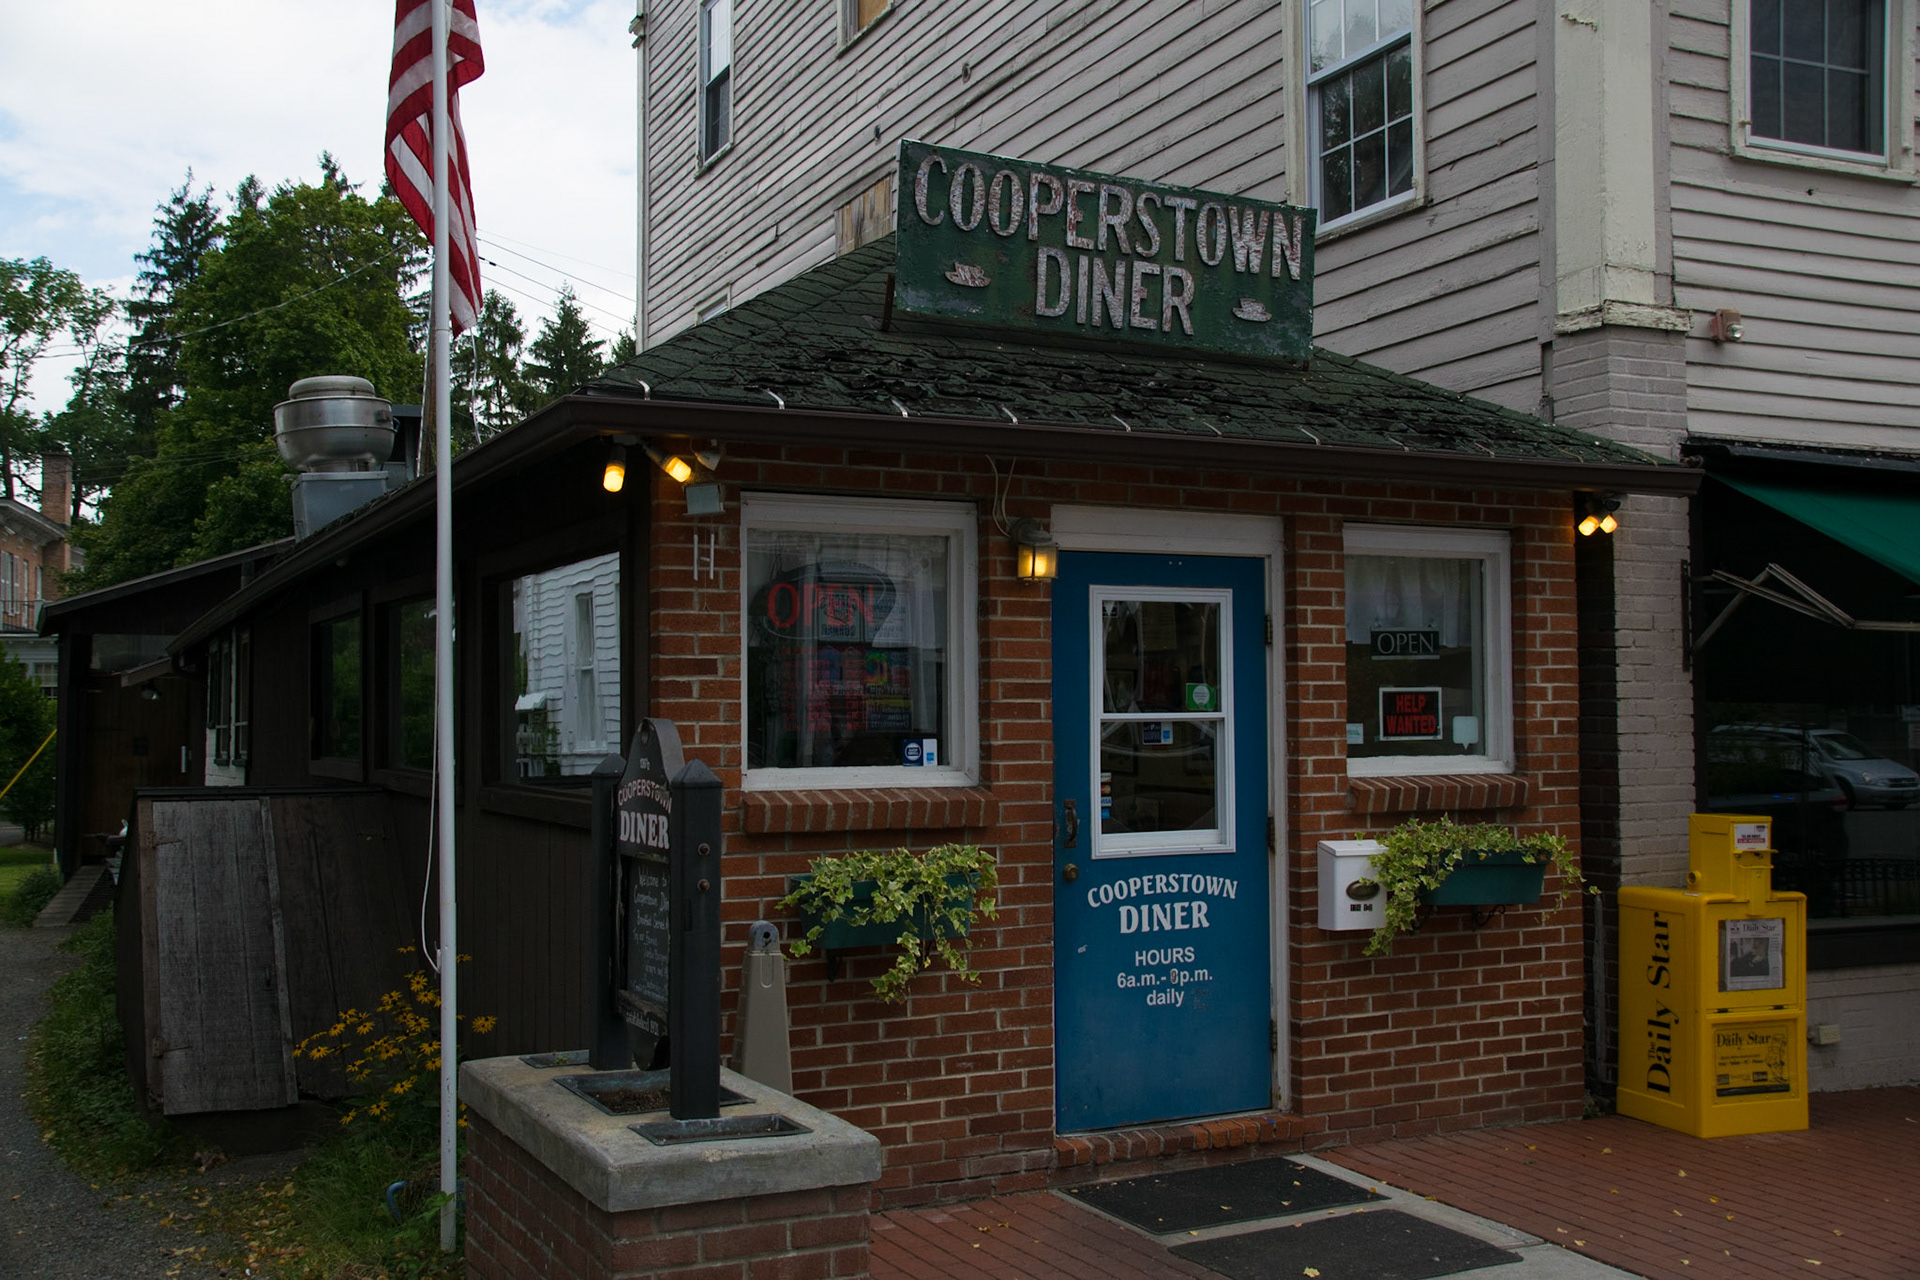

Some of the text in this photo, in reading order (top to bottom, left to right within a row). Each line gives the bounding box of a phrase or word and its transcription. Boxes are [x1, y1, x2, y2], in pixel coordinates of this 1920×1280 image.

[915, 154, 1303, 281] COOPERSTOWN
[1035, 245, 1194, 336] DINER
[767, 581, 875, 628] OPEN
[1377, 632, 1435, 655] OPEN
[1395, 694, 1427, 713] HELP
[1386, 714, 1437, 736] WANTED
[617, 778, 673, 814] COOPERSTOWN
[619, 810, 670, 850] DINER
[1087, 873, 1239, 908] COOPERSTOWN
[1119, 900, 1210, 934] DINER
[1743, 923, 1776, 933] Daily Star
[1135, 945, 1196, 967] HOURS
[1146, 988, 1185, 1008] daily
[1646, 911, 1680, 1095] The Daily Star
[1717, 1032, 1743, 1051] Daily
[1747, 1032, 1771, 1045] Star
